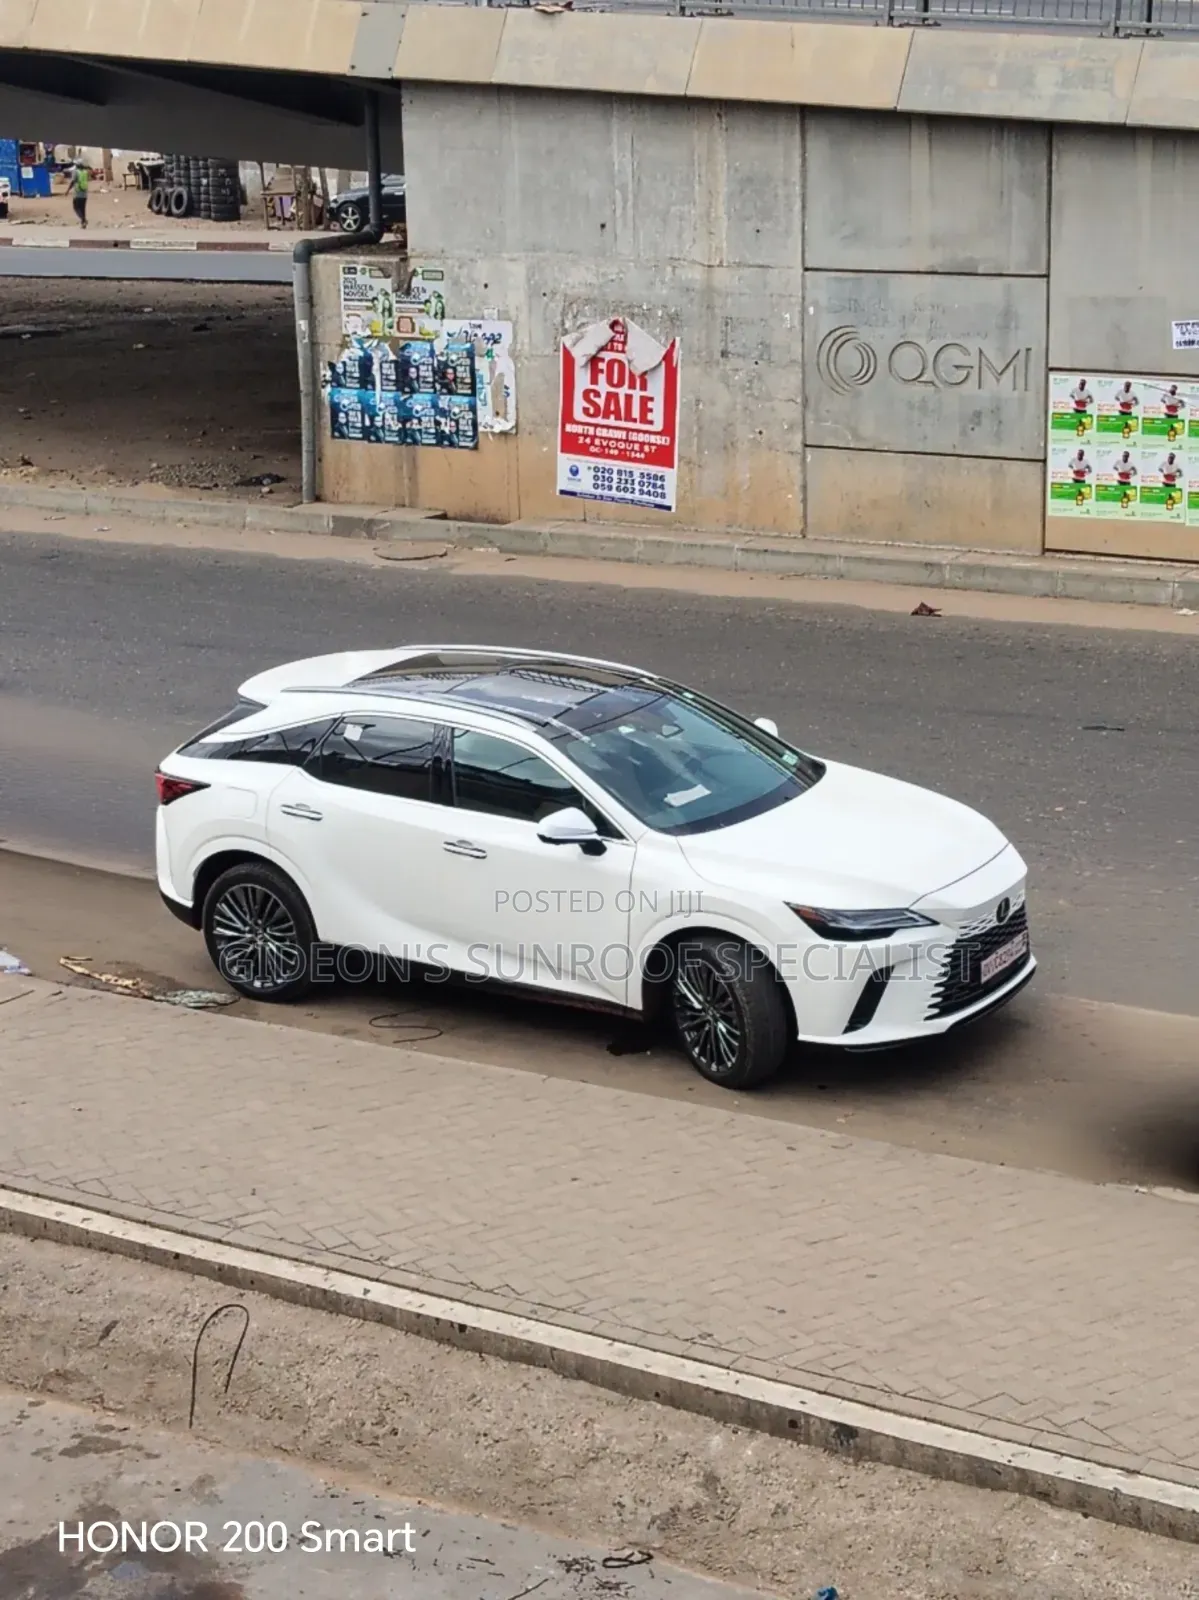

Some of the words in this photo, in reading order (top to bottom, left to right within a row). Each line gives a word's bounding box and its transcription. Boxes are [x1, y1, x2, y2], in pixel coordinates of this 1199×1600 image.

[888, 340, 1033, 392] QGMI
[582, 388, 655, 425] SALE
[578, 436, 591, 444] 24
[594, 438, 640, 450] EVOQUE
[643, 444, 657, 453] ST
[593, 465, 614, 475] 020
[616, 469, 634, 478] 815
[592, 483, 613, 491] 059
[615, 485, 636, 495] 602
[638, 489, 666, 499] 9408
[593, 474, 613, 484] 030
[638, 480, 665, 491] 0784
